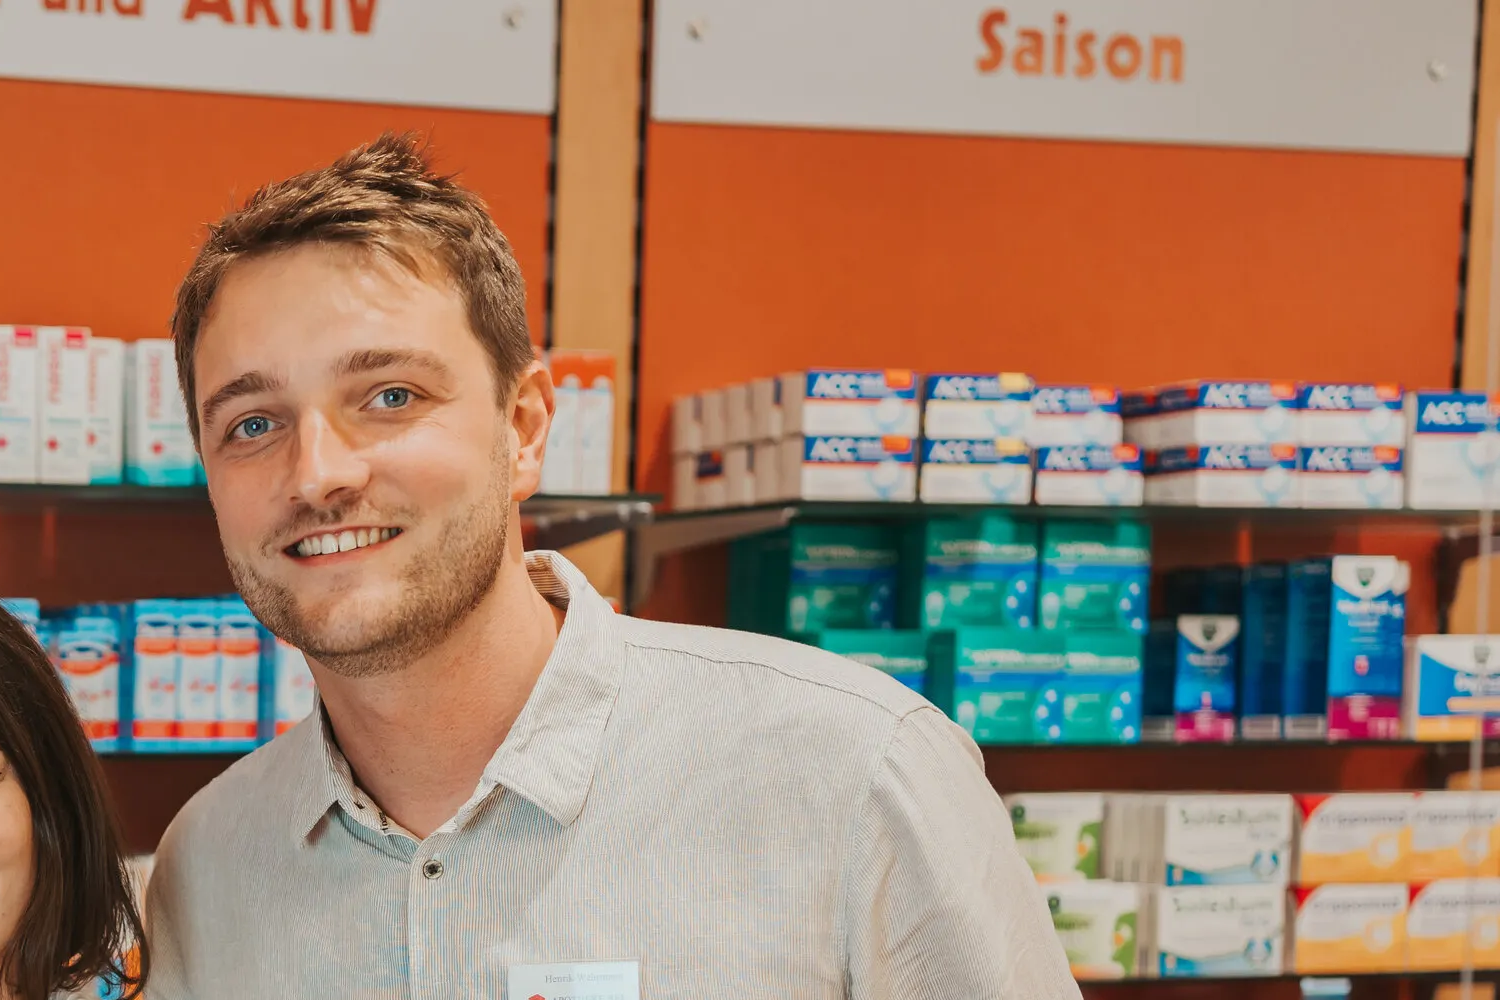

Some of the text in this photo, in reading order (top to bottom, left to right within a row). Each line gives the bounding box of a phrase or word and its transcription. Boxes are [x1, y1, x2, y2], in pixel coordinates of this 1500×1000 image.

[977, 7, 1185, 82] Saison
[811, 374, 858, 398] ACC
[932, 376, 976, 399] ACC
[1203, 384, 1248, 408] ACC
[1307, 384, 1351, 408] ACC
[1422, 401, 1466, 425] ACC
[809, 437, 857, 461] ACC
[928, 439, 971, 463] ACC
[1044, 447, 1091, 470] ACC
[1204, 446, 1248, 469] ACC
[1306, 447, 1351, 471] ACC
